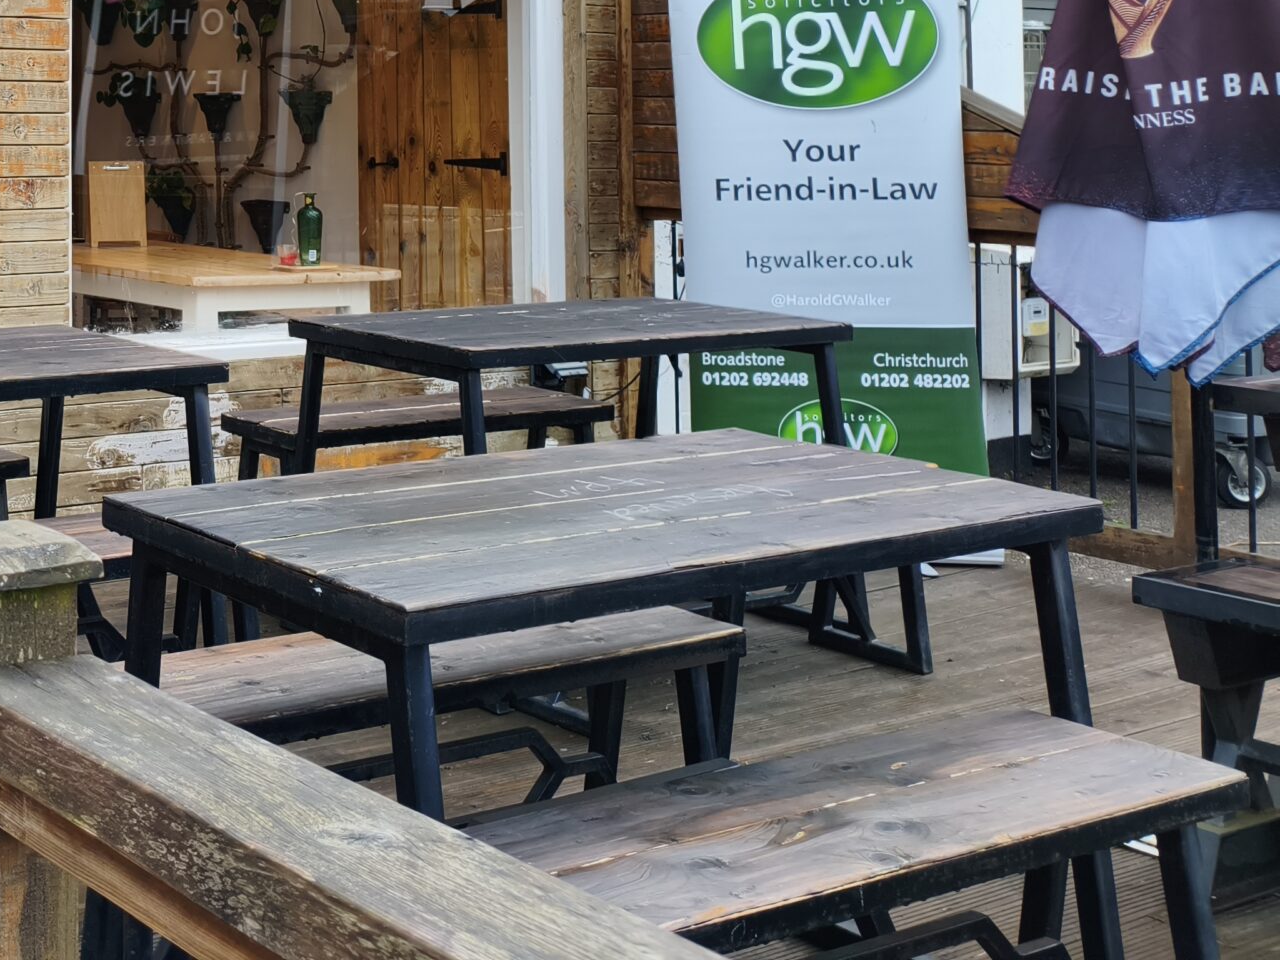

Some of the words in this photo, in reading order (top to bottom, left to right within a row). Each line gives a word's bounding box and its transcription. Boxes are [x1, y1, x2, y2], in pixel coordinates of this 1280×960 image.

[1039, 66, 1131, 101] RAIS
[1144, 76, 1209, 108] THE
[1223, 71, 1280, 98] BA
[1133, 108, 1196, 129] NNESS
[783, 139, 861, 162] Your
[715, 176, 938, 201] Friend-in-Law
[745, 250, 914, 274] hgwalker.co.uk
[771, 293, 892, 308] @HaroldGWalker
[701, 352, 785, 367] Broadstone
[873, 352, 968, 368] Christchurch
[701, 372, 749, 386] 01202
[753, 372, 809, 387] 692448
[861, 373, 909, 388] 01202
[913, 373, 970, 389] 482202
[804, 412, 882, 422] soitors
[795, 410, 887, 453] hw
